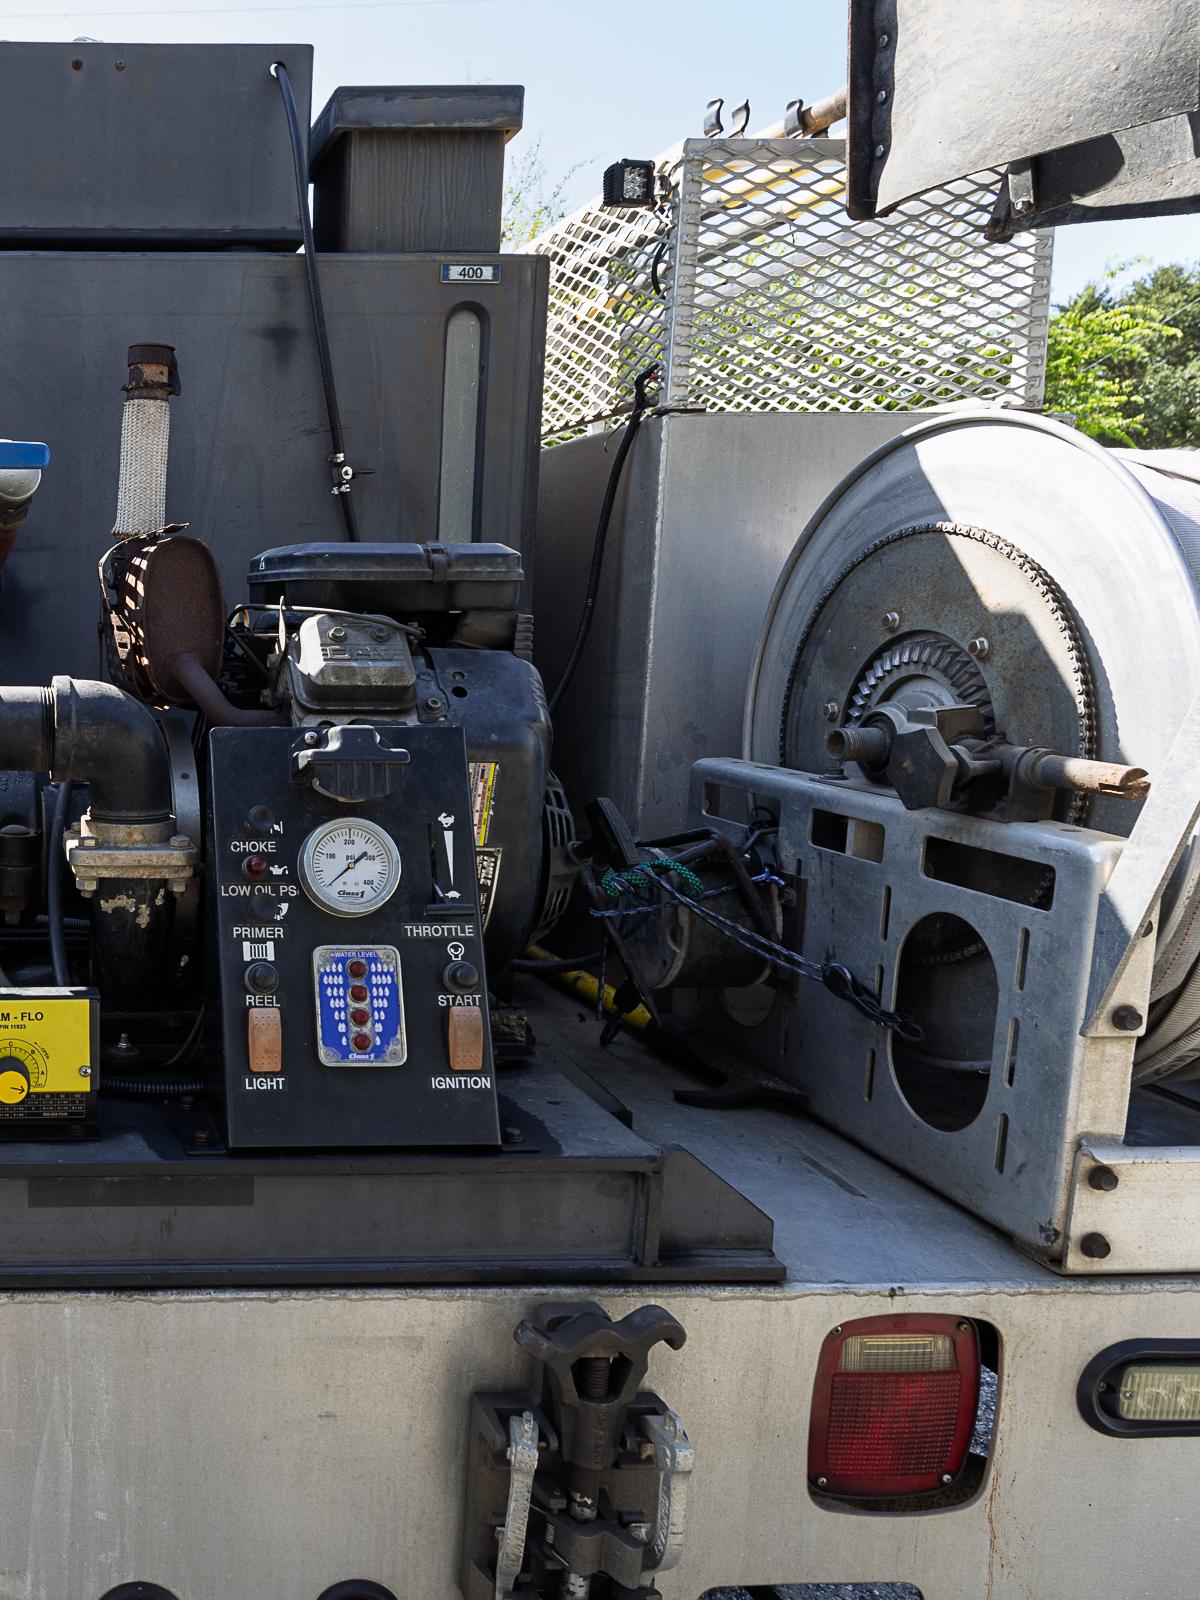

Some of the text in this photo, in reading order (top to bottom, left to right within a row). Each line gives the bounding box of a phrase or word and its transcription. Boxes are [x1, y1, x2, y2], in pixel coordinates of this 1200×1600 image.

[458, 267, 483, 278] 400
[230, 841, 277, 852] CHOKE
[345, 853, 356, 861] psi
[221, 885, 251, 896] LOW
[254, 885, 277, 896] OIL
[233, 927, 284, 938] PRIMER
[404, 925, 475, 937] THROTTLE
[246, 995, 280, 1007] REEL
[438, 994, 482, 1007] START
[20, 1011, 44, 1021] FLO
[245, 1078, 285, 1090] LIGHT
[431, 1076, 491, 1089] IGNITION
